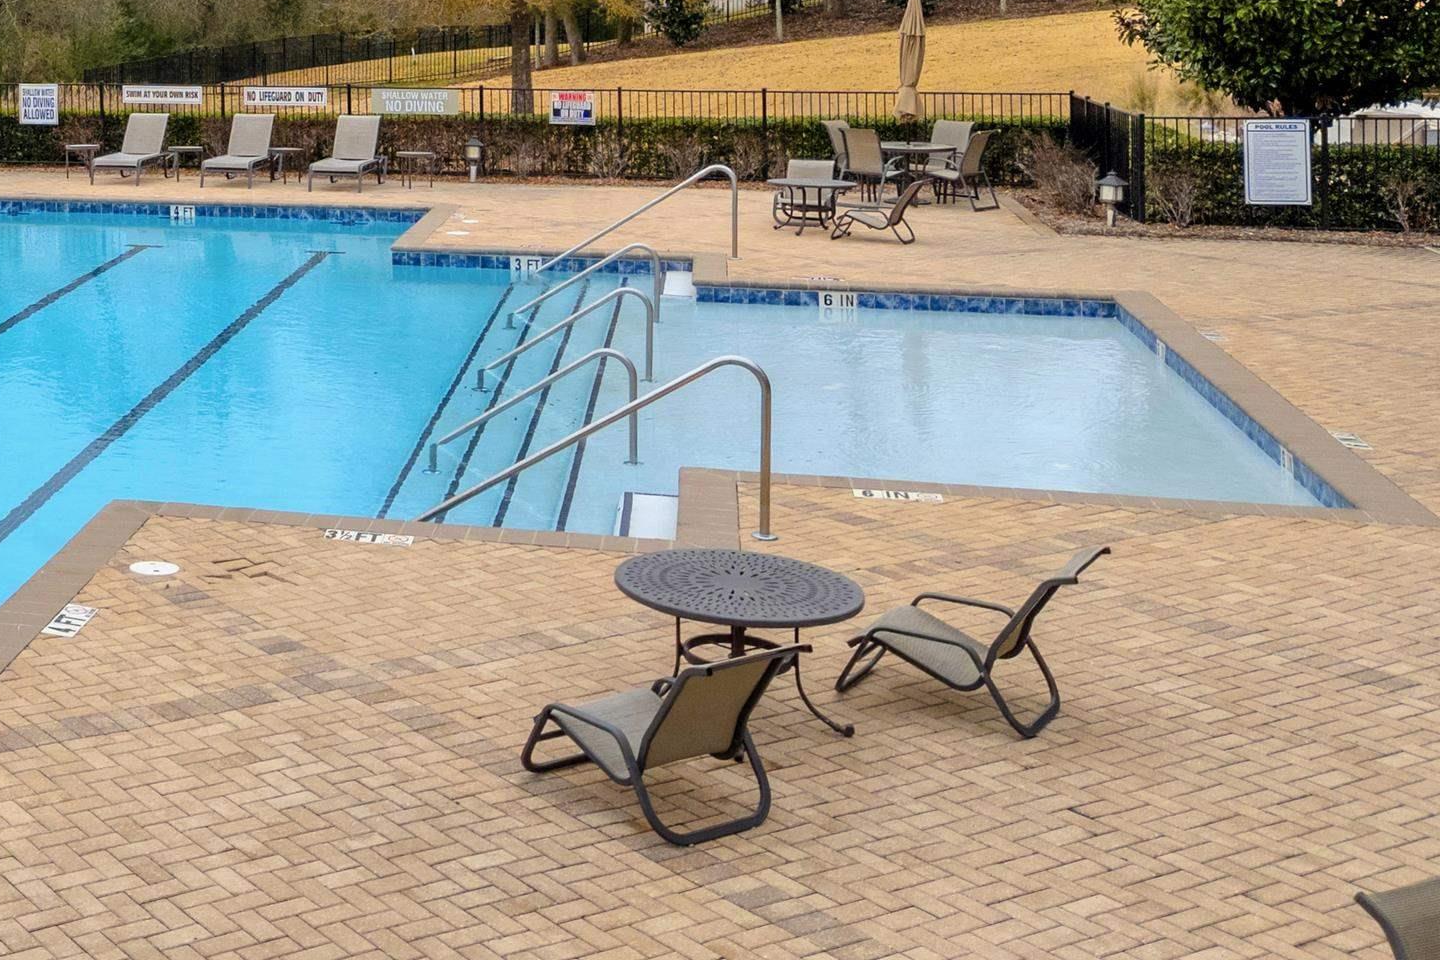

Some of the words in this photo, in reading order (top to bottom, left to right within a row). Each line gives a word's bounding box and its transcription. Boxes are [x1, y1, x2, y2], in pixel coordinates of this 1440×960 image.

[247, 91, 256, 101] NO
[259, 91, 292, 101] LIFEGUARD
[295, 91, 305, 102] ON
[308, 92, 324, 102] DUTY
[382, 91, 418, 100] SHALLOW
[420, 92, 448, 100] WATER
[23, 97, 31, 108] NO
[33, 97, 55, 108] DIVING
[385, 100, 401, 112] NO
[405, 100, 444, 112] DIVING
[24, 109, 54, 119] ALLOWED
[515, 258, 521, 270] 3
[527, 259, 540, 270] FT
[824, 294, 832, 306] 6
[840, 294, 854, 307] IN
[885, 491, 910, 499] IN
[355, 532, 382, 543] FT
